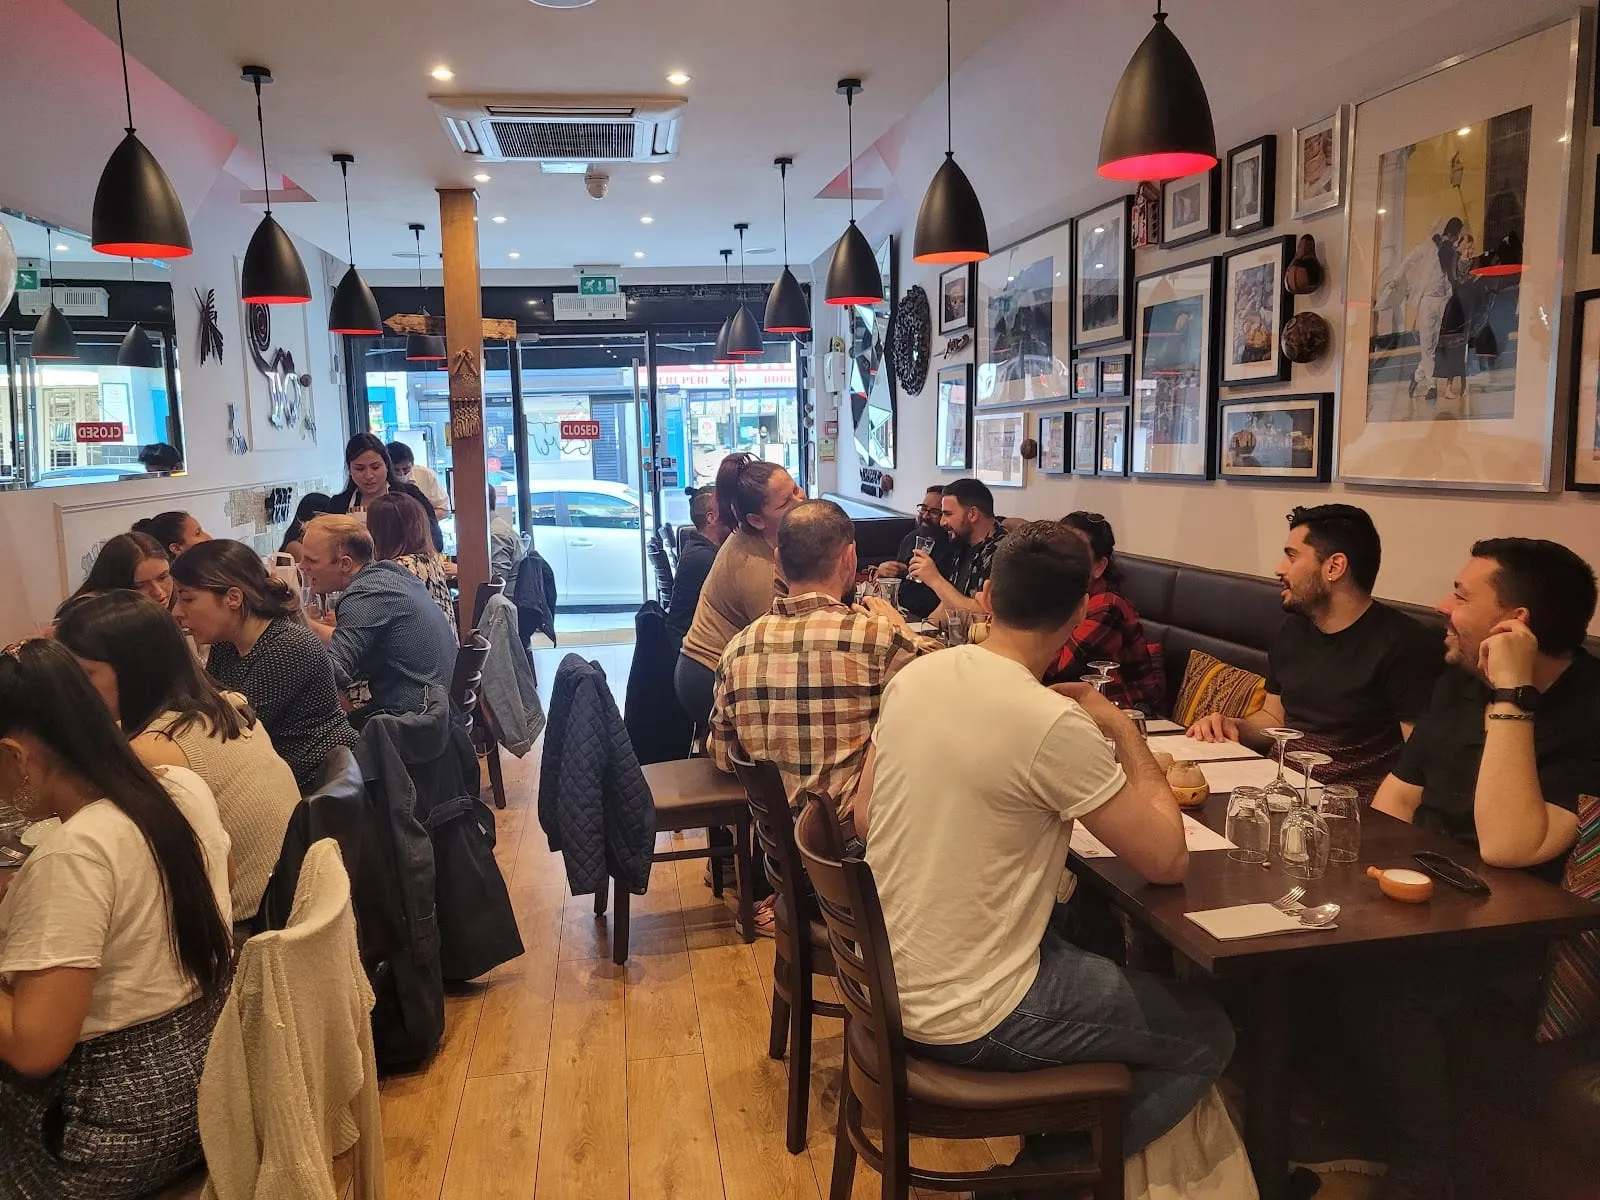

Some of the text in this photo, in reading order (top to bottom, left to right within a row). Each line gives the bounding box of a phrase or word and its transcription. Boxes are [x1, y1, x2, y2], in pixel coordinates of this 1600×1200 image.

[682, 376, 708, 385] PERI
[764, 375, 795, 384] BURG
[562, 424, 598, 436] CLOSED
